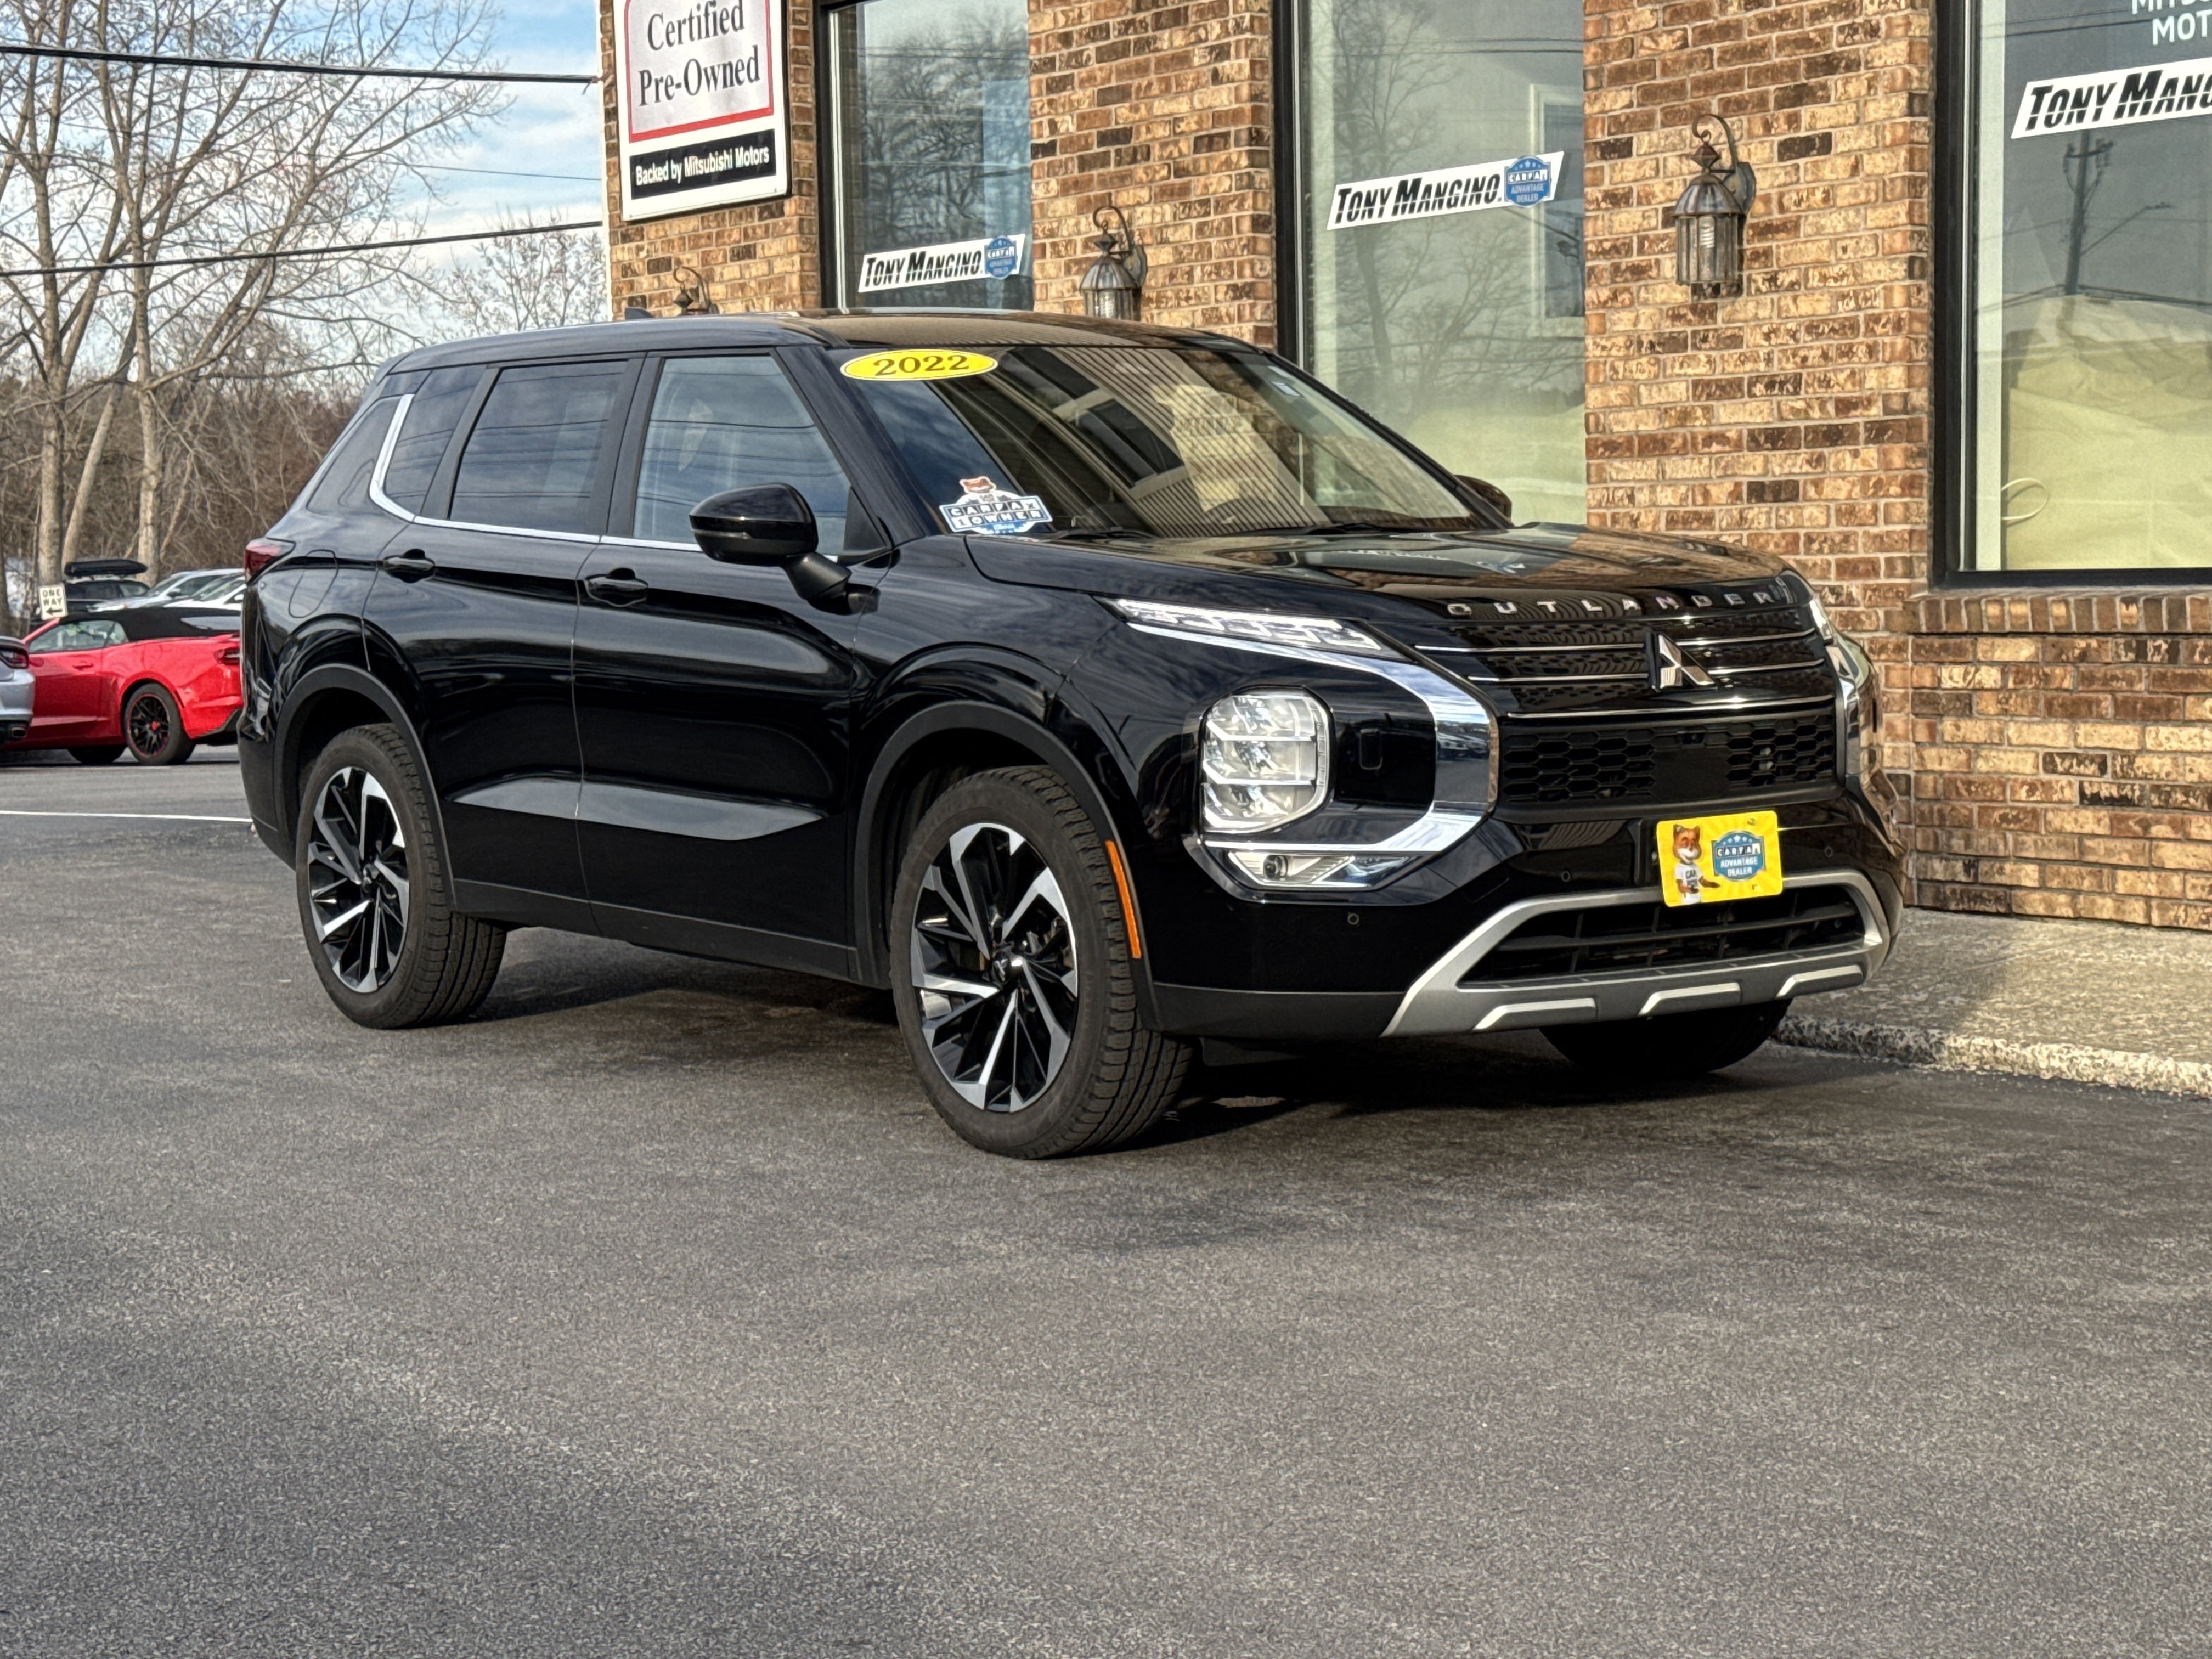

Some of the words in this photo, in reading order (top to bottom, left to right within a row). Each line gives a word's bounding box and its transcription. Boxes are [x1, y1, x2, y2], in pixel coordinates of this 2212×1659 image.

[647, 0, 744, 50] Certified
[639, 44, 760, 106] Pre-Owned
[2025, 82, 2118, 131] TONY
[635, 160, 669, 186] Backed
[670, 159, 682, 184] by
[684, 148, 733, 177] Mitsubishi
[735, 146, 769, 168] Motors
[1335, 187, 1393, 224] TONY
[1391, 173, 1500, 217] MANGINO
[865, 257, 906, 287] TONY
[905, 250, 982, 283] MANGINO
[873, 355, 969, 376] 2022
[950, 500, 1037, 517] CARFAX
[42, 588, 61, 598] ONE
[43, 597, 62, 606] WAY
[1447, 590, 1775, 616] OUTLANDER
[1720, 856, 1758, 868] ADVANTAGE
[1728, 866, 1753, 877] DEALER
